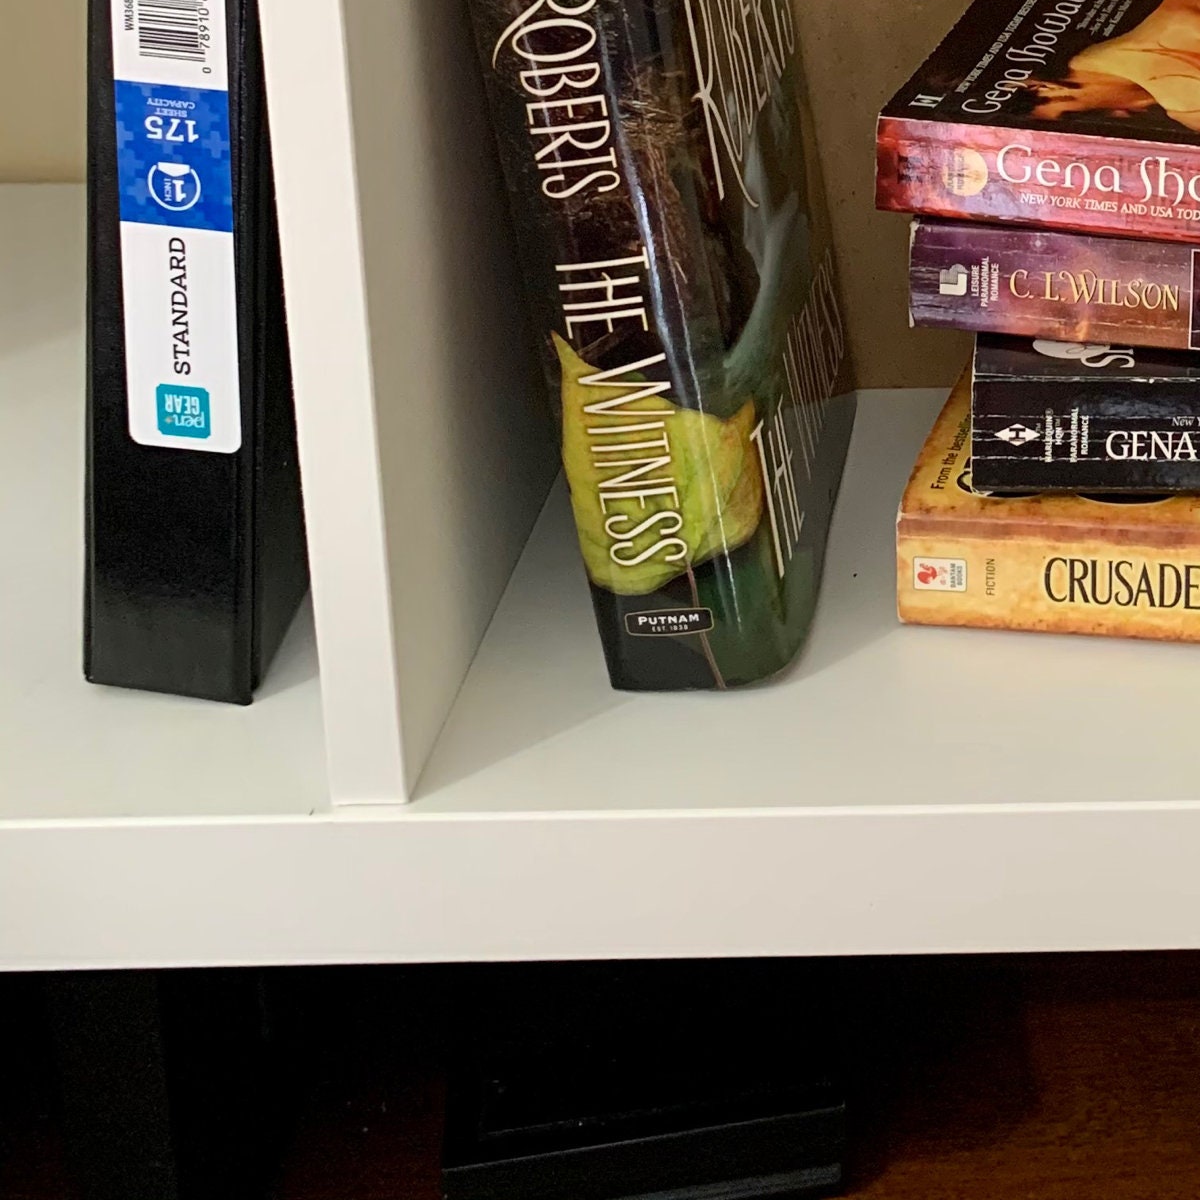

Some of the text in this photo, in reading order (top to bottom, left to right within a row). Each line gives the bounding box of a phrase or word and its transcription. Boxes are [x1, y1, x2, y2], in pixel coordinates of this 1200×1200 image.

[198, 7, 211, 49] 78910
[146, 97, 196, 110] CAPACITY
[961, 64, 1033, 115] Gena
[144, 115, 199, 143] 175
[154, 107, 188, 119] SHEET
[163, 178, 173, 202] INCH
[996, 143, 1123, 197] Gena
[172, 179, 187, 203] 1
[1020, 192, 1049, 208] NEW
[1049, 195, 1082, 210] YORK
[1084, 198, 1118, 213] TIMES
[1121, 201, 1148, 216] AND
[1150, 204, 1173, 219] USA
[555, 246, 650, 341] THE
[970, 263, 980, 297] LEISURE
[979, 255, 990, 308] PARANORMAL
[990, 262, 1000, 302] ROMANCE
[1009, 268, 1035, 300] C.
[1058, 268, 1181, 313] WILSON
[171, 236, 192, 376] STANDARD
[782, 247, 844, 482] WITNESS
[164, 393, 201, 415] GEAR
[1171, 416, 1194, 427] New
[1068, 406, 1081, 464] PARANORMAL
[1080, 414, 1091, 455] ROMANCE
[1105, 430, 1198, 461] GENA
[577, 352, 690, 568] WITNESS
[930, 467, 952, 490] From
[942, 452, 958, 465] the
[749, 394, 806, 580] THE
[985, 557, 996, 597] FICTION
[637, 612, 700, 626] PUTNAM
